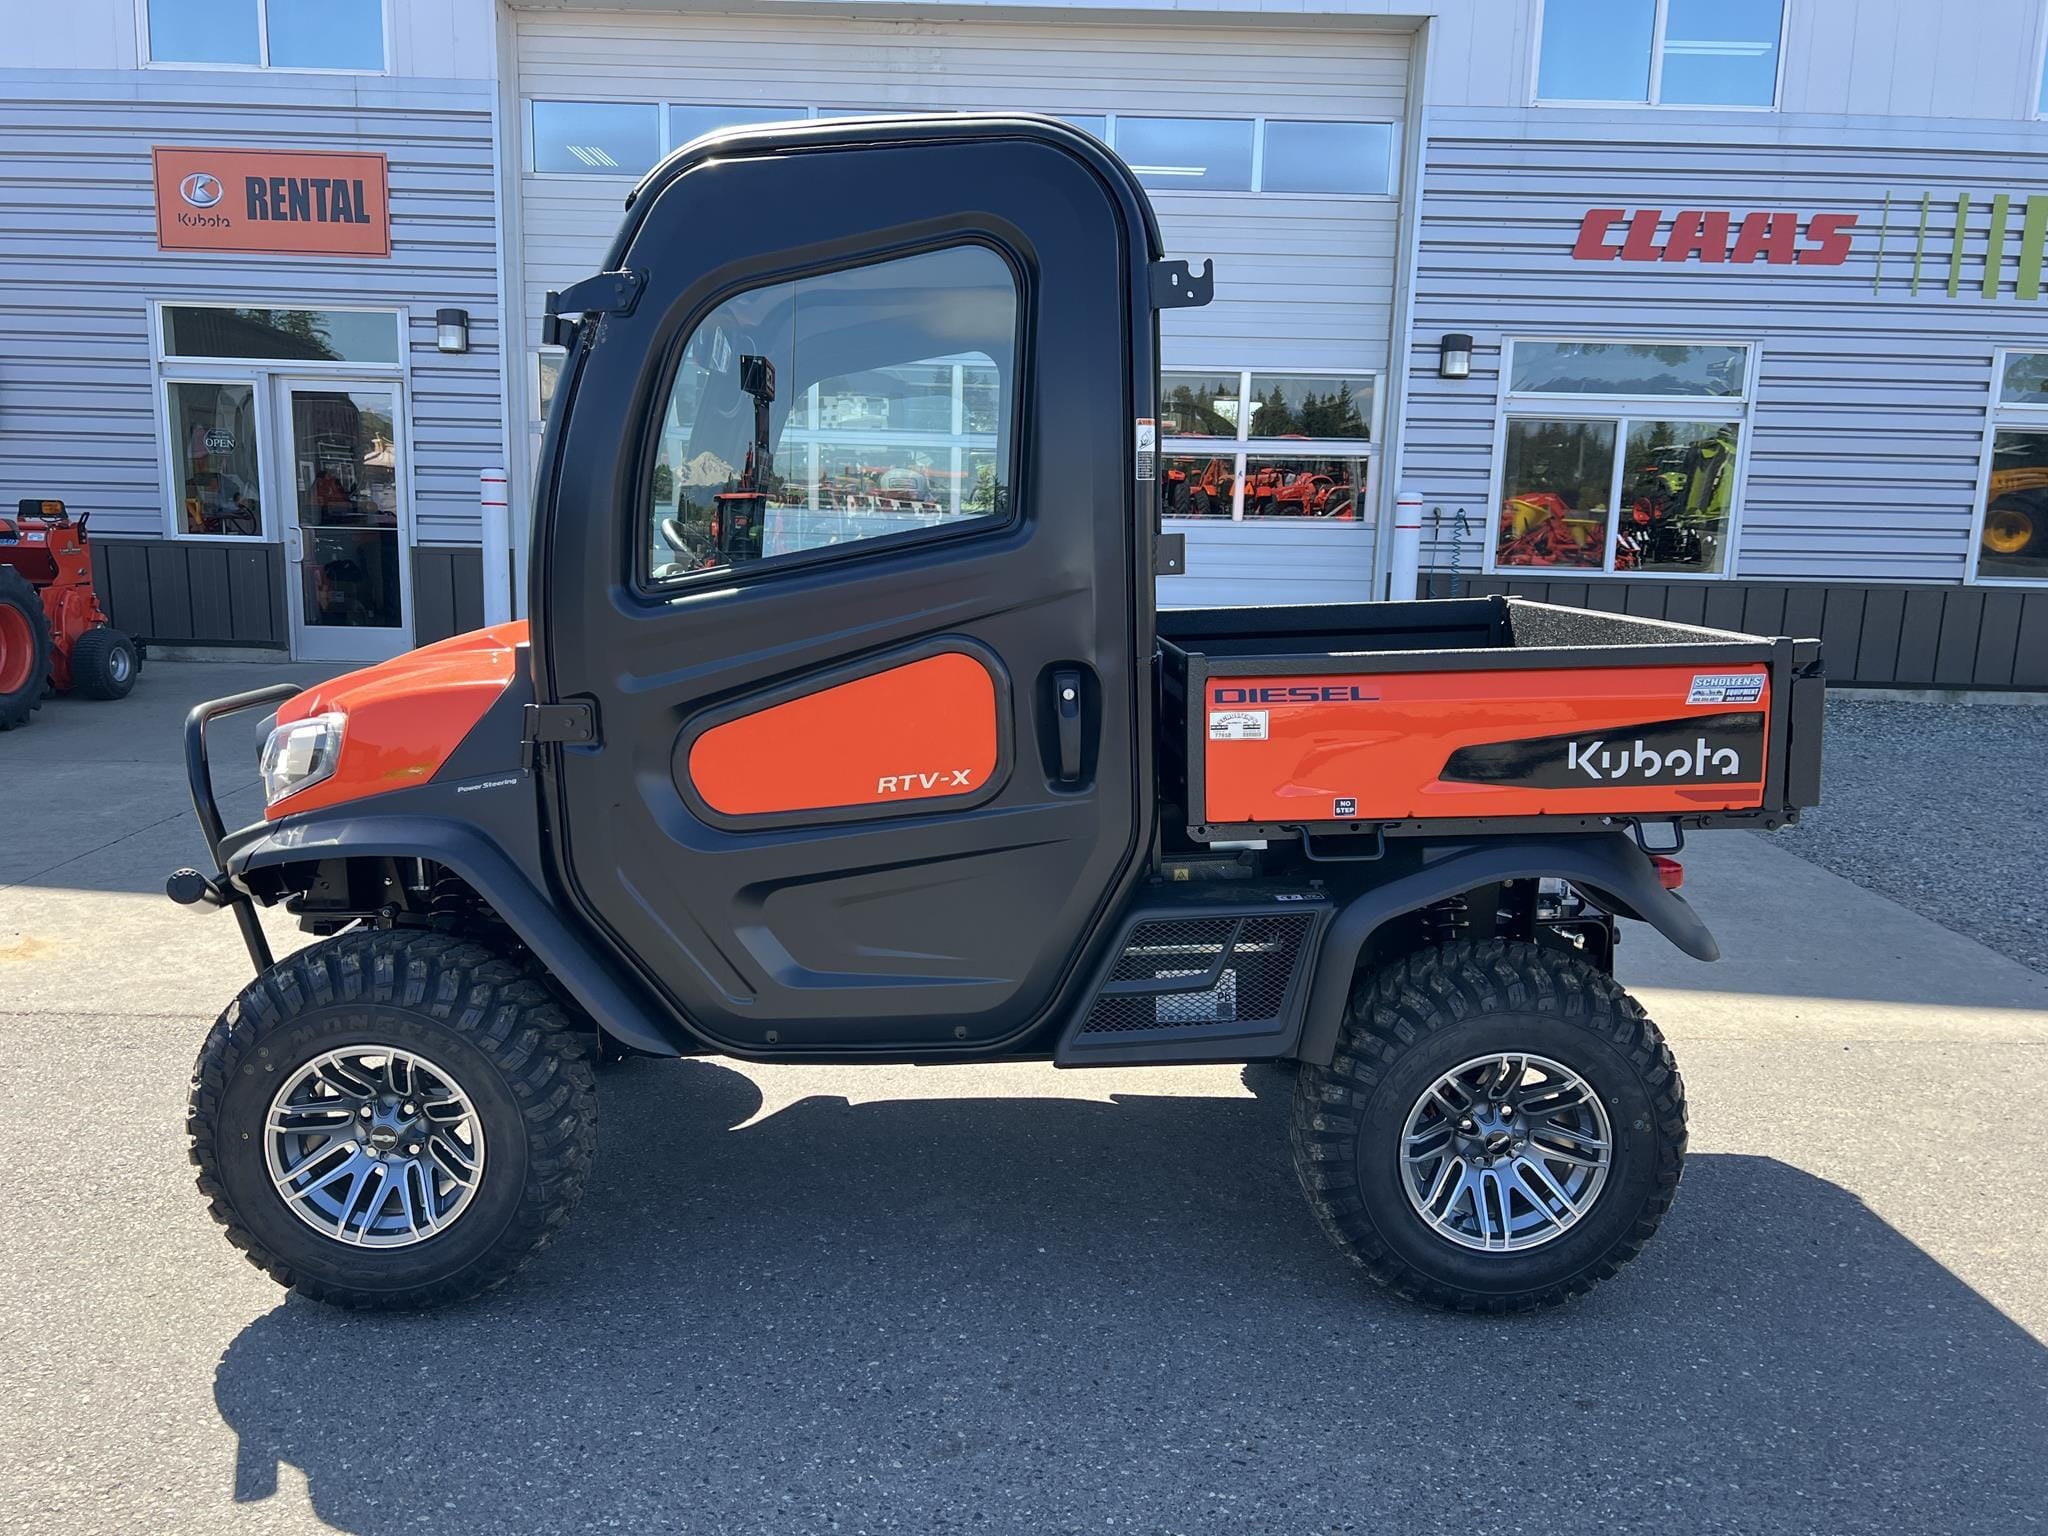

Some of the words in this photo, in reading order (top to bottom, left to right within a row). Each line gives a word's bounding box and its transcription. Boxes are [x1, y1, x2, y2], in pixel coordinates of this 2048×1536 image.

[245, 176, 371, 224] RENTAL
[177, 212, 231, 228] Kubota
[1572, 209, 1859, 265] CLAAS
[205, 438, 235, 448] OPEN
[1695, 676, 1762, 687] SCHOLTEN'S
[1214, 686, 1380, 704] DIESEL
[1568, 738, 1740, 780] Kubota
[457, 784, 482, 793] Power
[482, 778, 517, 788] Steering
[877, 769, 972, 794] RTV-X
